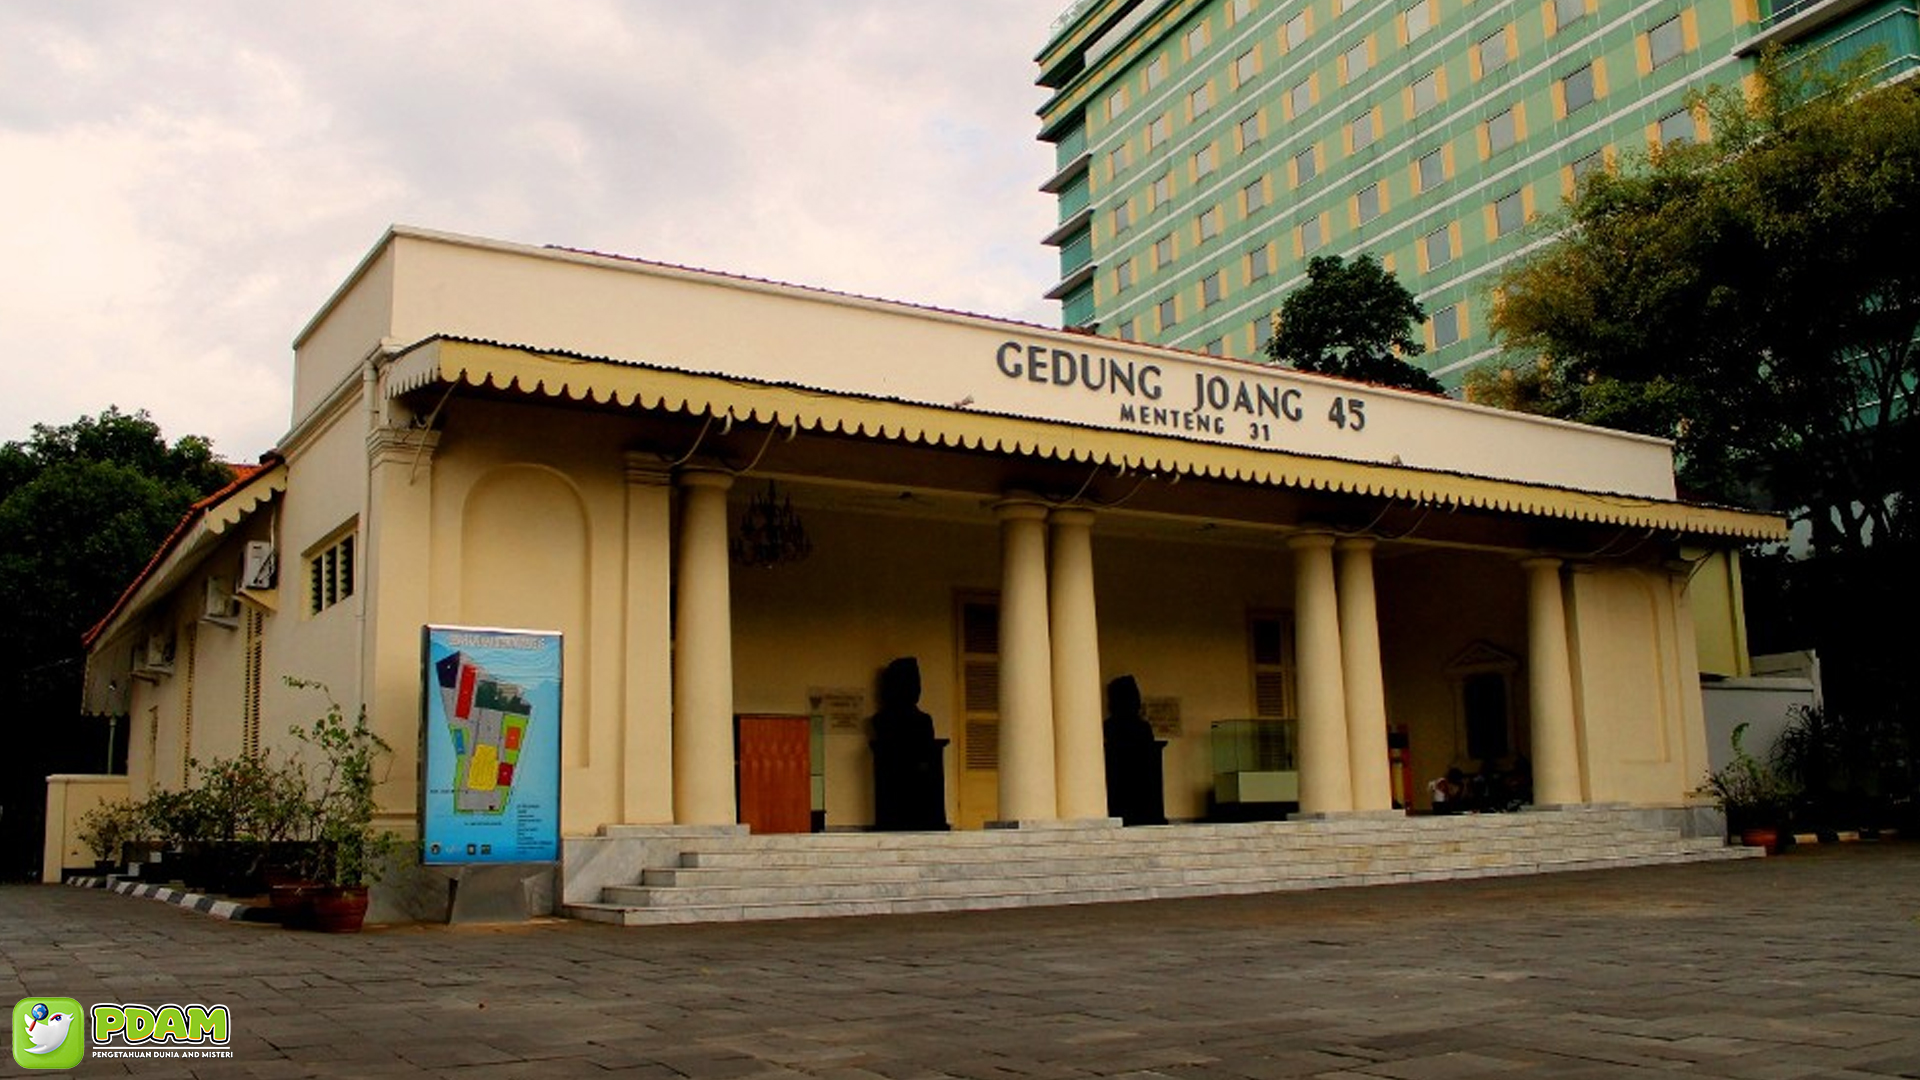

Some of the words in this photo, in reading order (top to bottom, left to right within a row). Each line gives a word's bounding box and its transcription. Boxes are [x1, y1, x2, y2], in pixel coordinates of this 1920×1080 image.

[996, 341, 1162, 400] GEDUNG
[1194, 374, 1303, 422] JOANG
[1328, 397, 1365, 431] 45
[1120, 403, 1225, 435] MENTENG
[1249, 422, 1270, 441] 31
